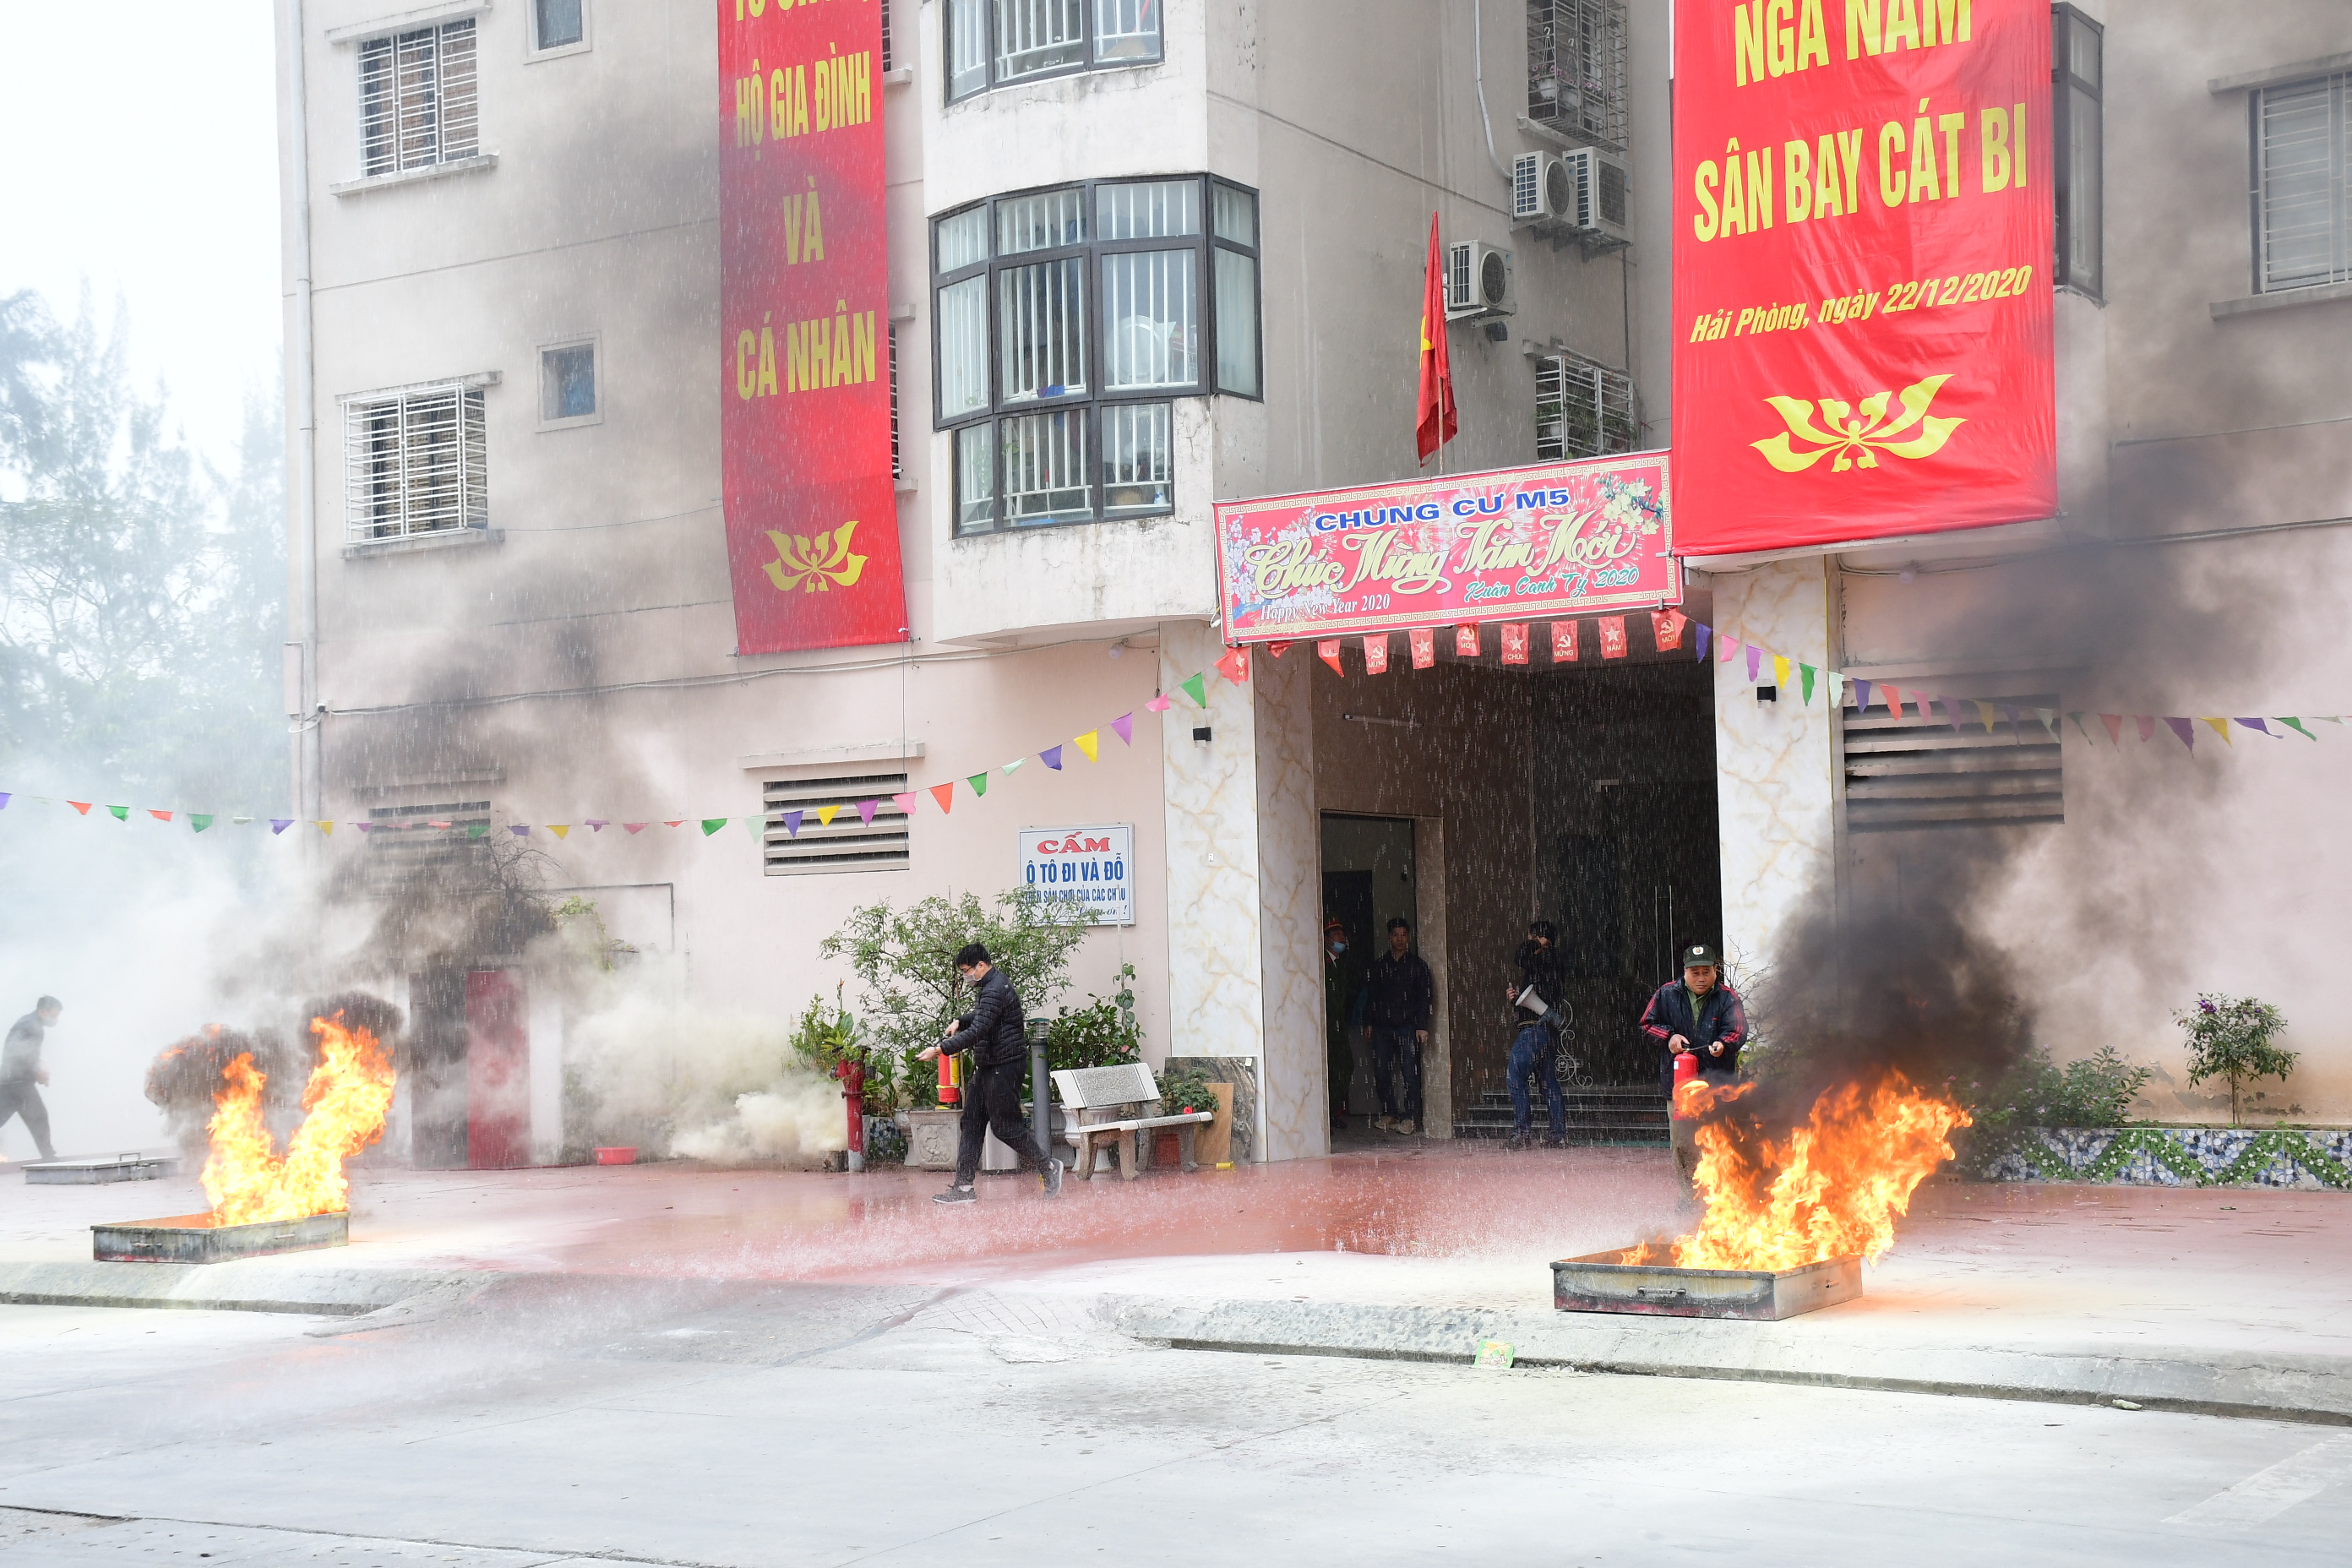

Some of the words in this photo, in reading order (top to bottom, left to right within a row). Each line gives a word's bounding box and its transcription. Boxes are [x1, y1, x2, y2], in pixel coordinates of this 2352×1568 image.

[736, 59, 763, 161] HỘ
[770, 65, 809, 141] GIA
[814, 42, 871, 133] ĐÌNH
[1694, 137, 1772, 242] SÂN
[1784, 128, 1863, 224] BAY
[1878, 97, 1965, 208] CÁT
[1981, 103, 2027, 193] BI
[783, 176, 825, 265] VÀ
[1690, 308, 1733, 343] Hải
[1734, 302, 1810, 335] Phòng,
[1817, 288, 1880, 324] ngày
[1882, 264, 2033, 313] 22/12/2020
[737, 311, 778, 400] CÁ
[787, 299, 875, 394] NHÂN
[1315, 504, 1440, 531] CHUNG
[1452, 493, 1505, 516] CƯ
[1516, 489, 1570, 509] M5
[1244, 538, 1345, 599] Chúc
[1330, 529, 1452, 595] Mừng
[1453, 519, 1535, 574] Năm
[1526, 510, 1637, 576] Mới
[1260, 604, 1298, 623] Happy
[1302, 601, 1328, 617] New
[1331, 597, 1358, 613] Year
[1361, 593, 1391, 611] 2020
[1464, 581, 1510, 602] Xuân
[1515, 577, 1557, 595] Canh
[1562, 572, 1589, 597] Tý
[1595, 568, 1639, 587] 2020
[1026, 860, 1036, 884] Ô
[1040, 859, 1057, 883] TÔ
[1062, 863, 1076, 882] ĐI
[1081, 858, 1099, 881] VÀ
[1104, 852, 1124, 881] ĐỖ
[1037, 831, 1111, 855] CẤM
[1092, 885, 1105, 901] CÁC
